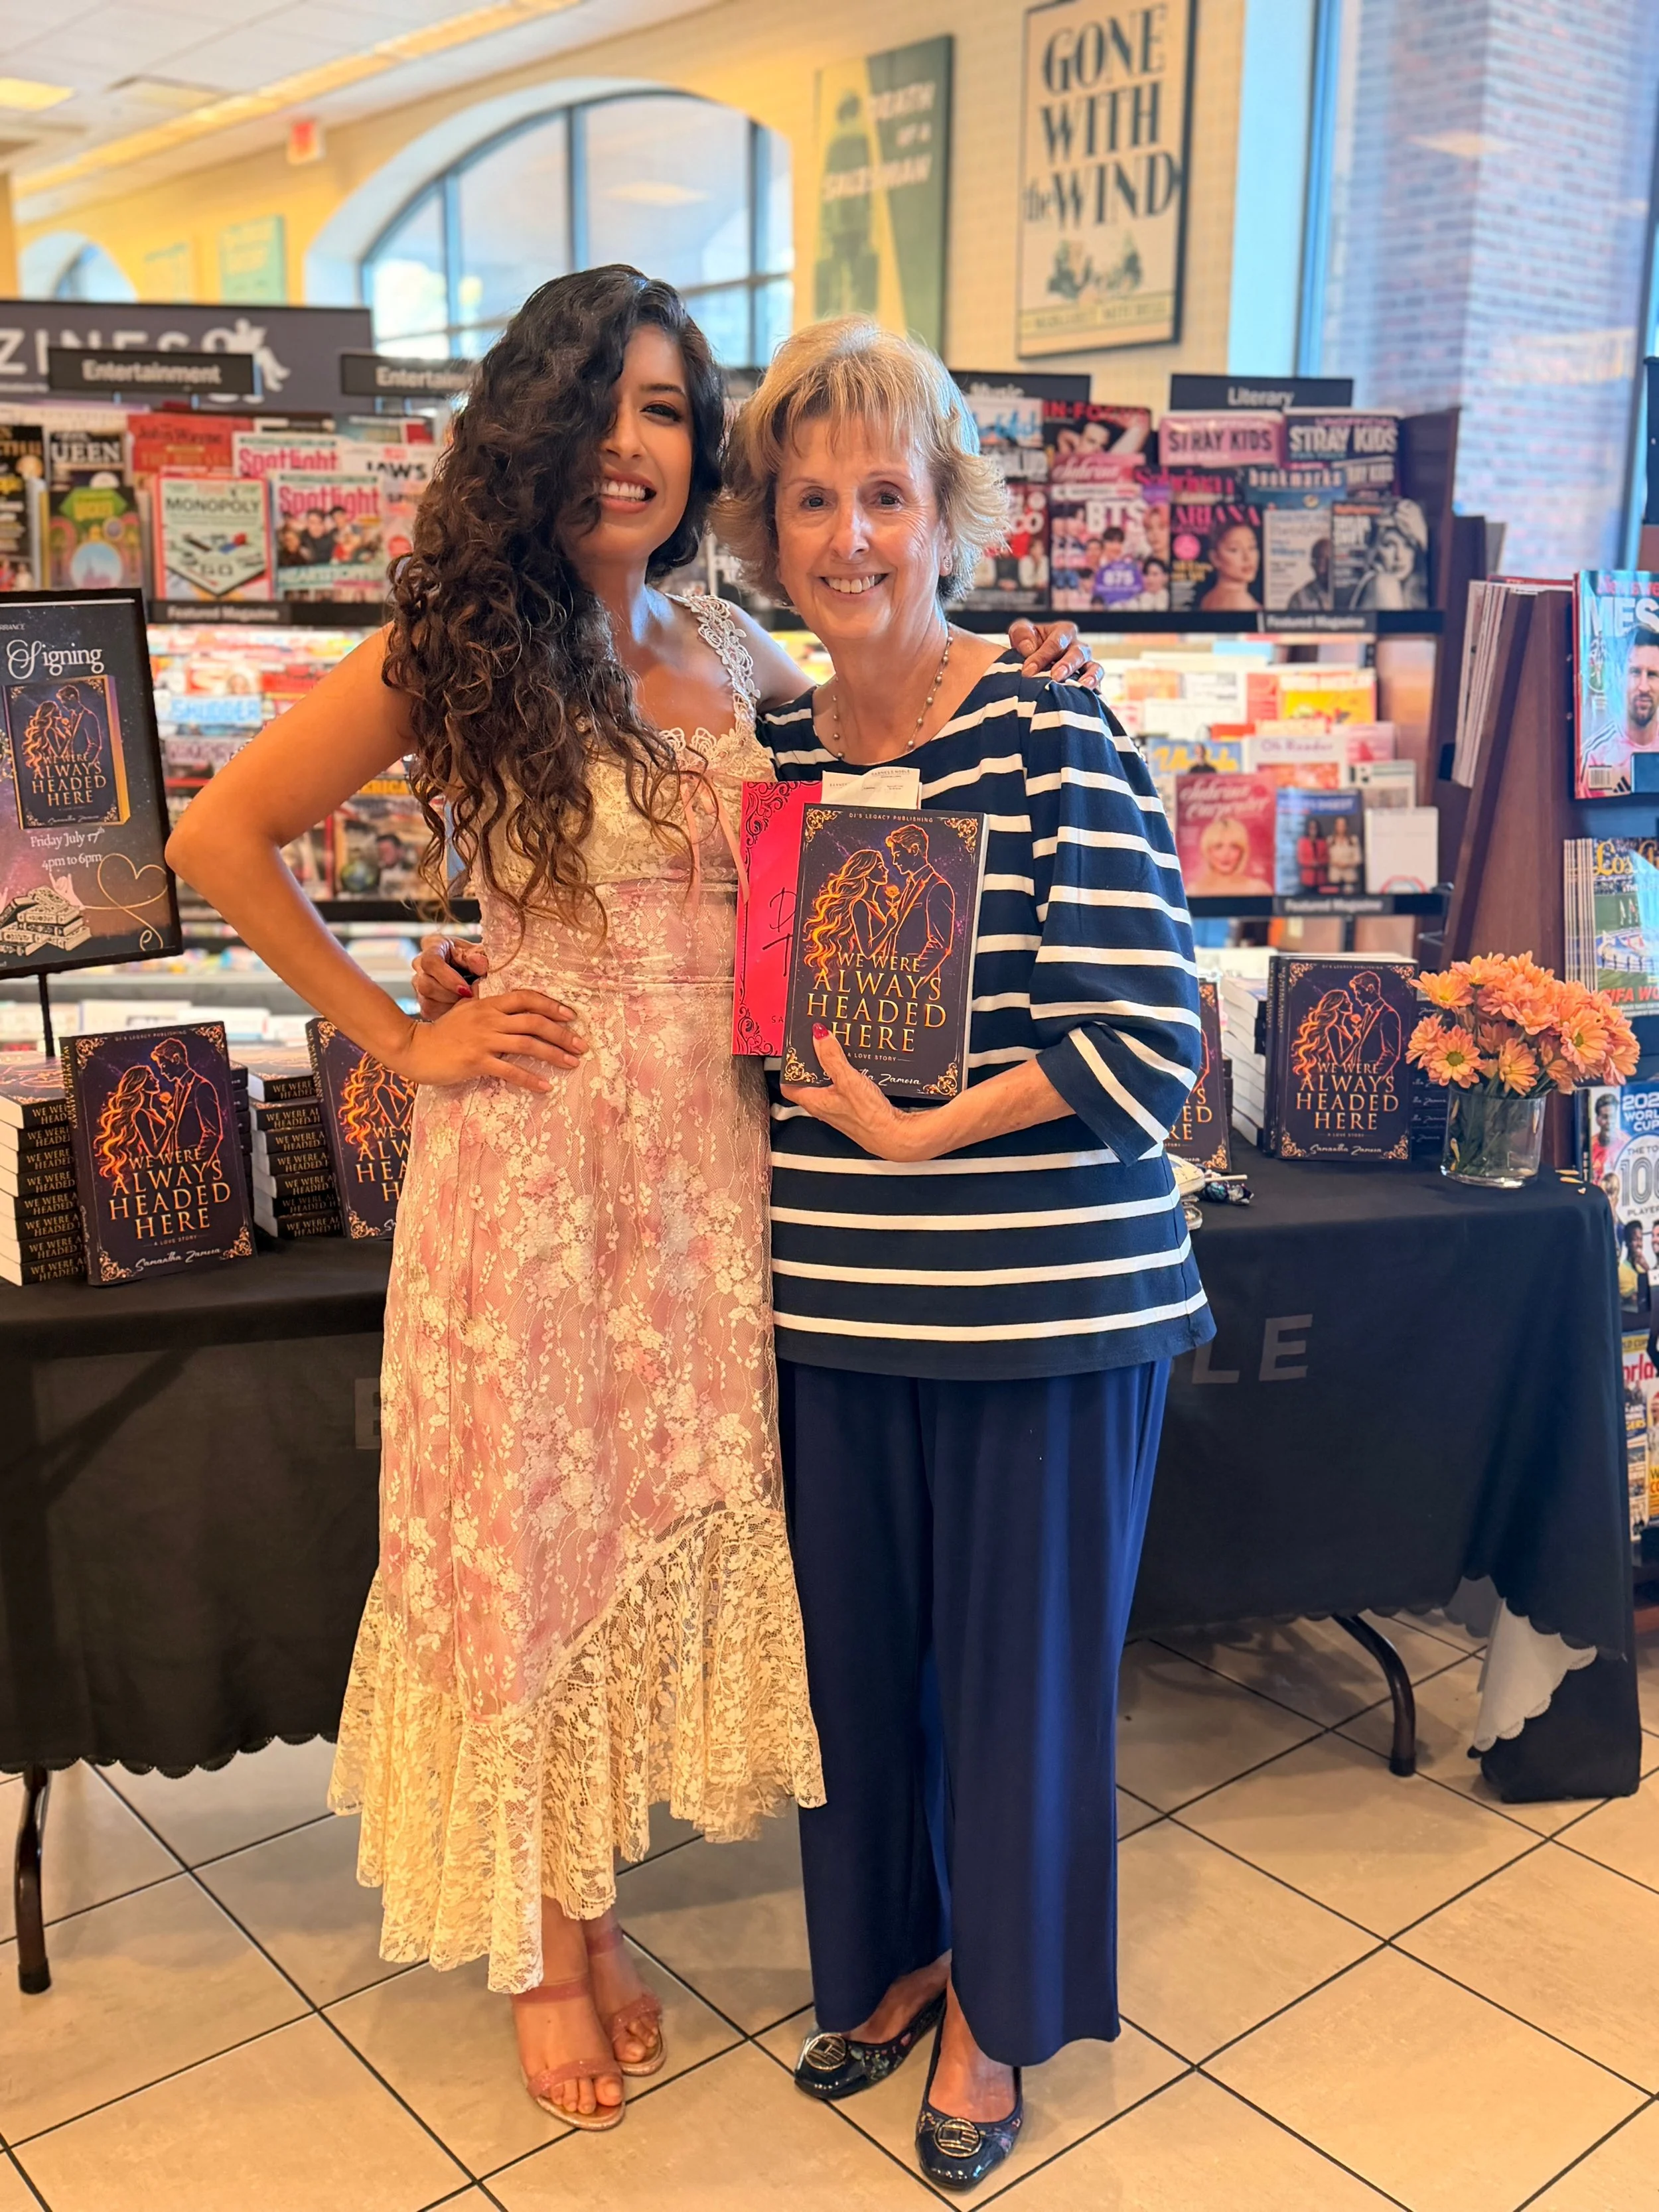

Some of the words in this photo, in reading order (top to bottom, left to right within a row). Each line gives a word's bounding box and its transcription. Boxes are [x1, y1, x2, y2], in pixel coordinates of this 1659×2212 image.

[1043, 3, 1167, 96] GONE
[1041, 80, 1161, 164] WITH
[1051, 151, 1179, 231] WIND
[81, 359, 223, 385] Entertainment
[1228, 387, 1295, 408] Literary
[1169, 428, 1226, 452] STRAY
[1230, 431, 1273, 452] KIDS
[1289, 425, 1350, 454] STRAY
[1354, 425, 1398, 454] KIDS
[166, 496, 259, 514] MONOPOLY
[278, 486, 381, 522] Spotlight
[1085, 500, 1147, 533] BTS
[167, 606, 220, 620] Featured
[222, 608, 279, 622] Magazine
[1266, 615, 1313, 628] Featured
[1315, 616, 1366, 630] Magazine
[7, 639, 105, 680] Signing
[34, 762, 102, 780] ALWAYS
[32, 775, 107, 794] HEADED
[48, 790, 94, 807] HERE
[893, 815, 934, 823] PUBLISHING
[31, 834, 64, 850] Friday
[65, 831, 85, 848] July
[42, 857, 65, 871] 4pm
[66, 855, 78, 865] to
[78, 852, 103, 867] 6pm
[1285, 899, 1327, 912] Featured
[1330, 899, 1382, 914] Magazine
[837, 951, 864, 968] WE
[871, 954, 920, 973] WERE
[812, 969, 942, 1002] ALWAYS
[806, 993, 946, 1028] HEADED
[831, 1022, 915, 1052] HERE
[875, 1054, 897, 1062] STORY
[1317, 1062, 1337, 1073] WE
[1342, 1063, 1378, 1074] WERE
[1300, 1074, 1395, 1093] ALWAYS
[1296, 1093, 1399, 1112] HEADED
[32, 1107, 46, 1118] WE
[266, 1112, 279, 1122] WE
[283, 1109, 305, 1120] WERE
[1314, 1111, 1378, 1130] HERE
[274, 1116, 311, 1129] HEADED
[27, 1131, 42, 1141] WE
[36, 1135, 70, 1147] HEADE
[275, 1135, 289, 1145] WE
[292, 1131, 317, 1142] WERE
[373, 1127, 397, 1139] WE
[283, 1139, 320, 1152] HEADED
[27, 1154, 42, 1164] WE
[44, 1148, 70, 1160] WERE
[129, 1154, 154, 1170] WE
[159, 1147, 202, 1166] WERE
[277, 1156, 291, 1166] WE
[293, 1153, 317, 1164] WERE
[285, 1160, 323, 1173] HEADED
[27, 1176, 42, 1186] WE
[44, 1170, 71, 1182] WERE
[112, 1160, 223, 1197] ALWAYS
[285, 1179, 299, 1189] WE
[301, 1175, 324, 1186] WERE
[35, 1179, 75, 1194] HEADED
[293, 1182, 329, 1196] HEADED
[24, 1198, 41, 1209] WE
[42, 1194, 69, 1205] WERE
[33, 1201, 74, 1215] HEADED
[108, 1182, 231, 1221] HEADED
[25, 1219, 42, 1230] WE
[43, 1214, 70, 1227] WERE
[34, 1221, 75, 1237] HEADED
[134, 1208, 210, 1239] HERE
[287, 1221, 301, 1231] WE
[303, 1217, 326, 1227] WERE
[29, 1242, 46, 1253] WE
[46, 1237, 73, 1249] WERE
[37, 1244, 78, 1260] HEADED
[30, 1265, 46, 1275] WE
[48, 1258, 74, 1271] WERE
[135, 1251, 182, 1272] Samantha
[38, 1267, 79, 1282] HEADED
